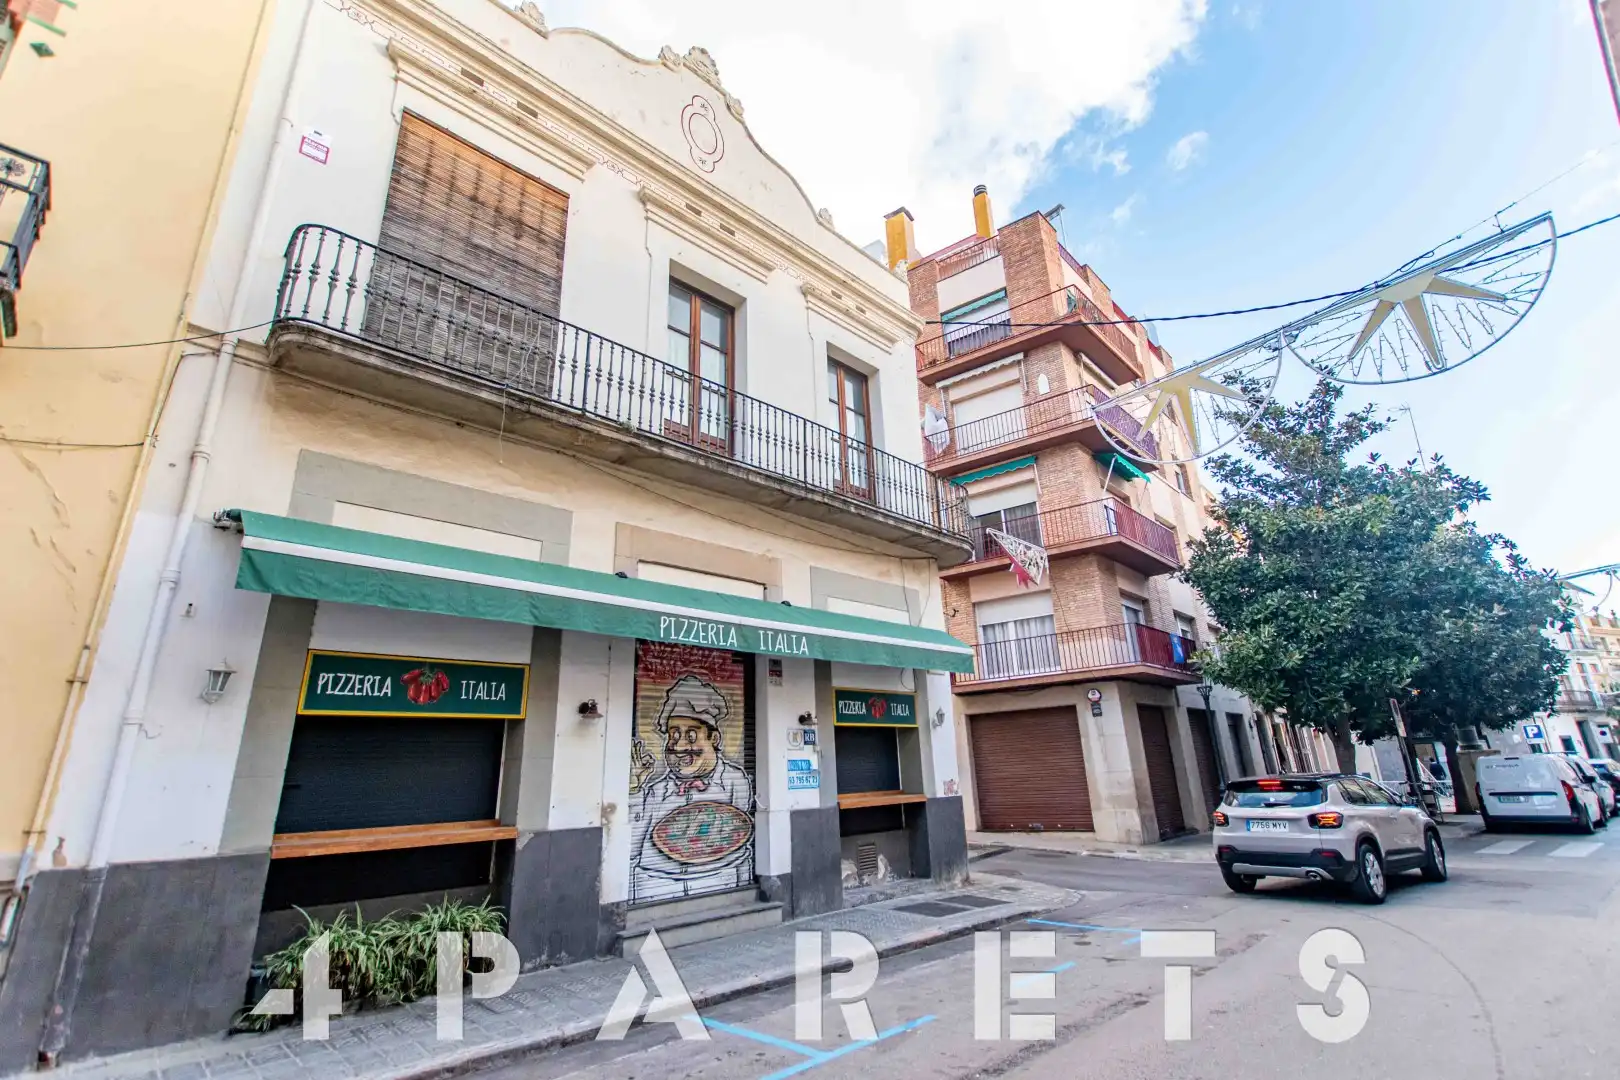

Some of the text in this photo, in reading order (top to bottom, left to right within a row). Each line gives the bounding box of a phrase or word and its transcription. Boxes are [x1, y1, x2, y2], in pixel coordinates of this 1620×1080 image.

[660, 616, 809, 655] PIZZERIA ITALIA
[316, 672, 506, 701] PIZZERIA ITALIA
[838, 700, 910, 717] PIZZERIA ITALIA
[1525, 725, 1539, 738] P
